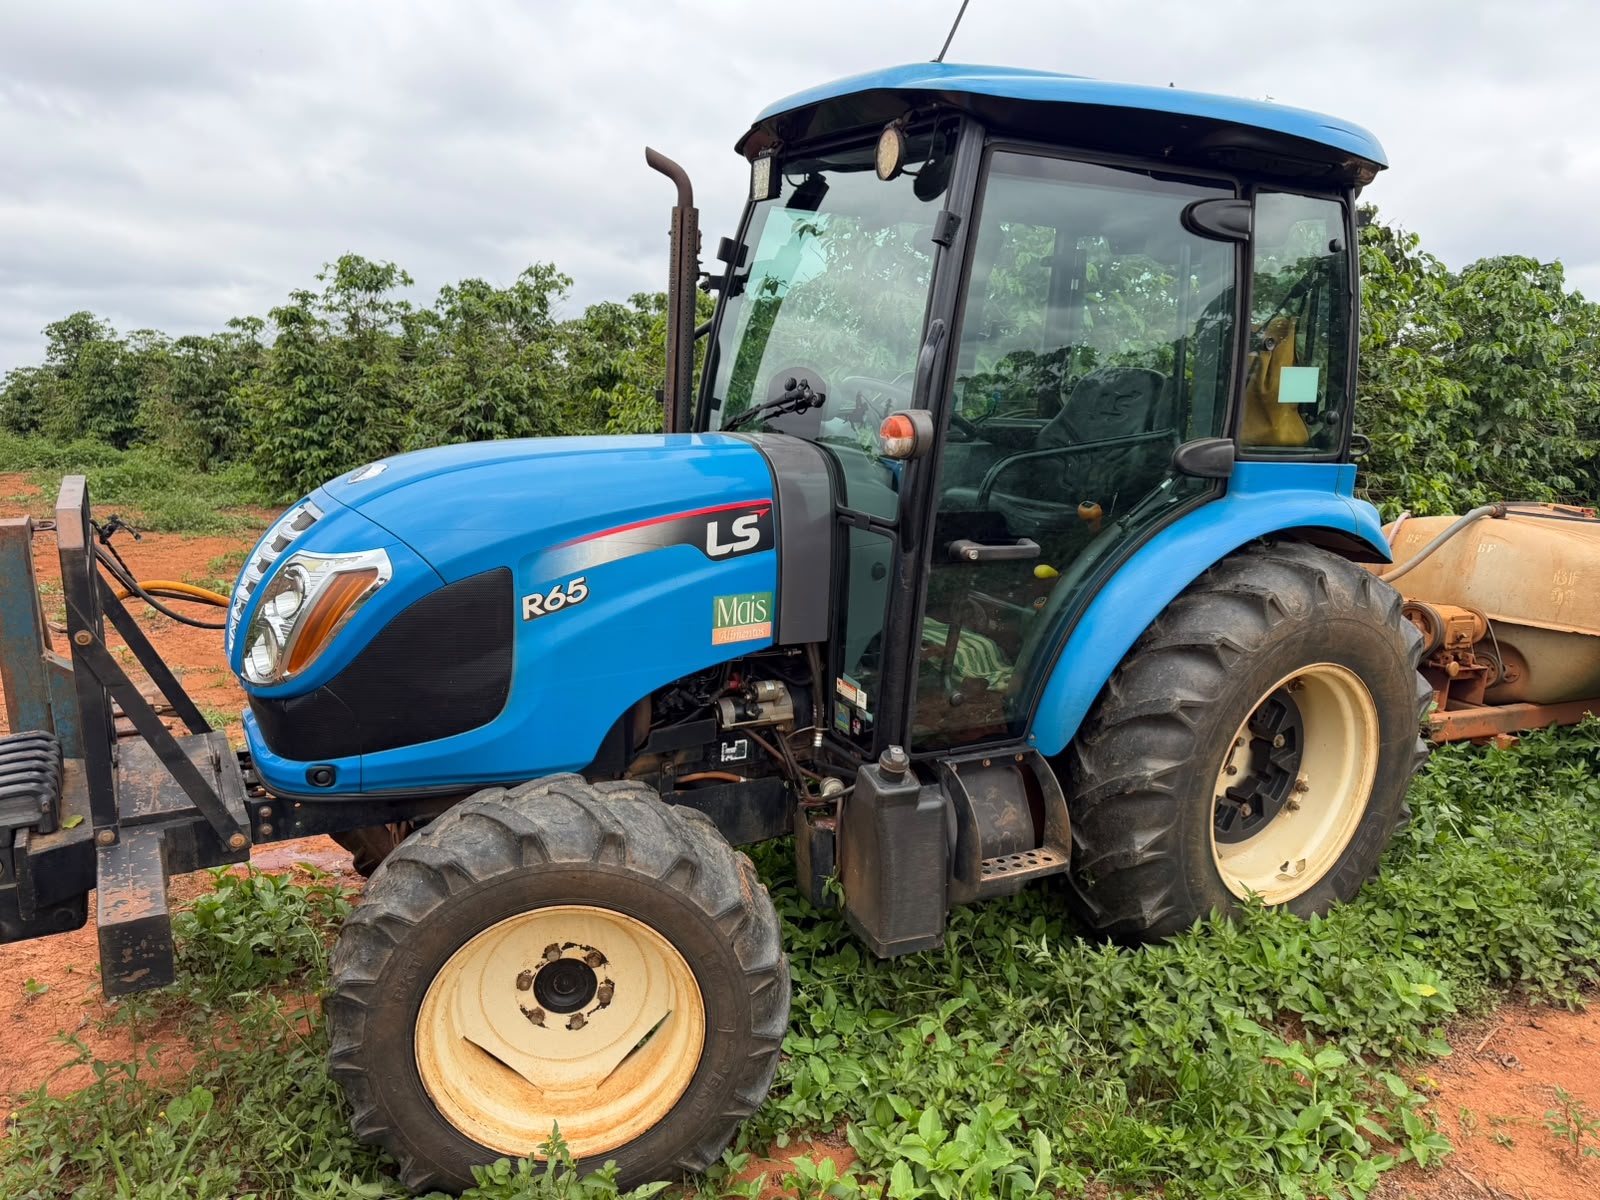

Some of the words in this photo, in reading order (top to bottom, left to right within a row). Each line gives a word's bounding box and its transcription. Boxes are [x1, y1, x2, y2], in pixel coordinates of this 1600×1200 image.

[706, 514, 761, 557] LS
[522, 576, 589, 621] R65
[717, 594, 767, 627] Mais
